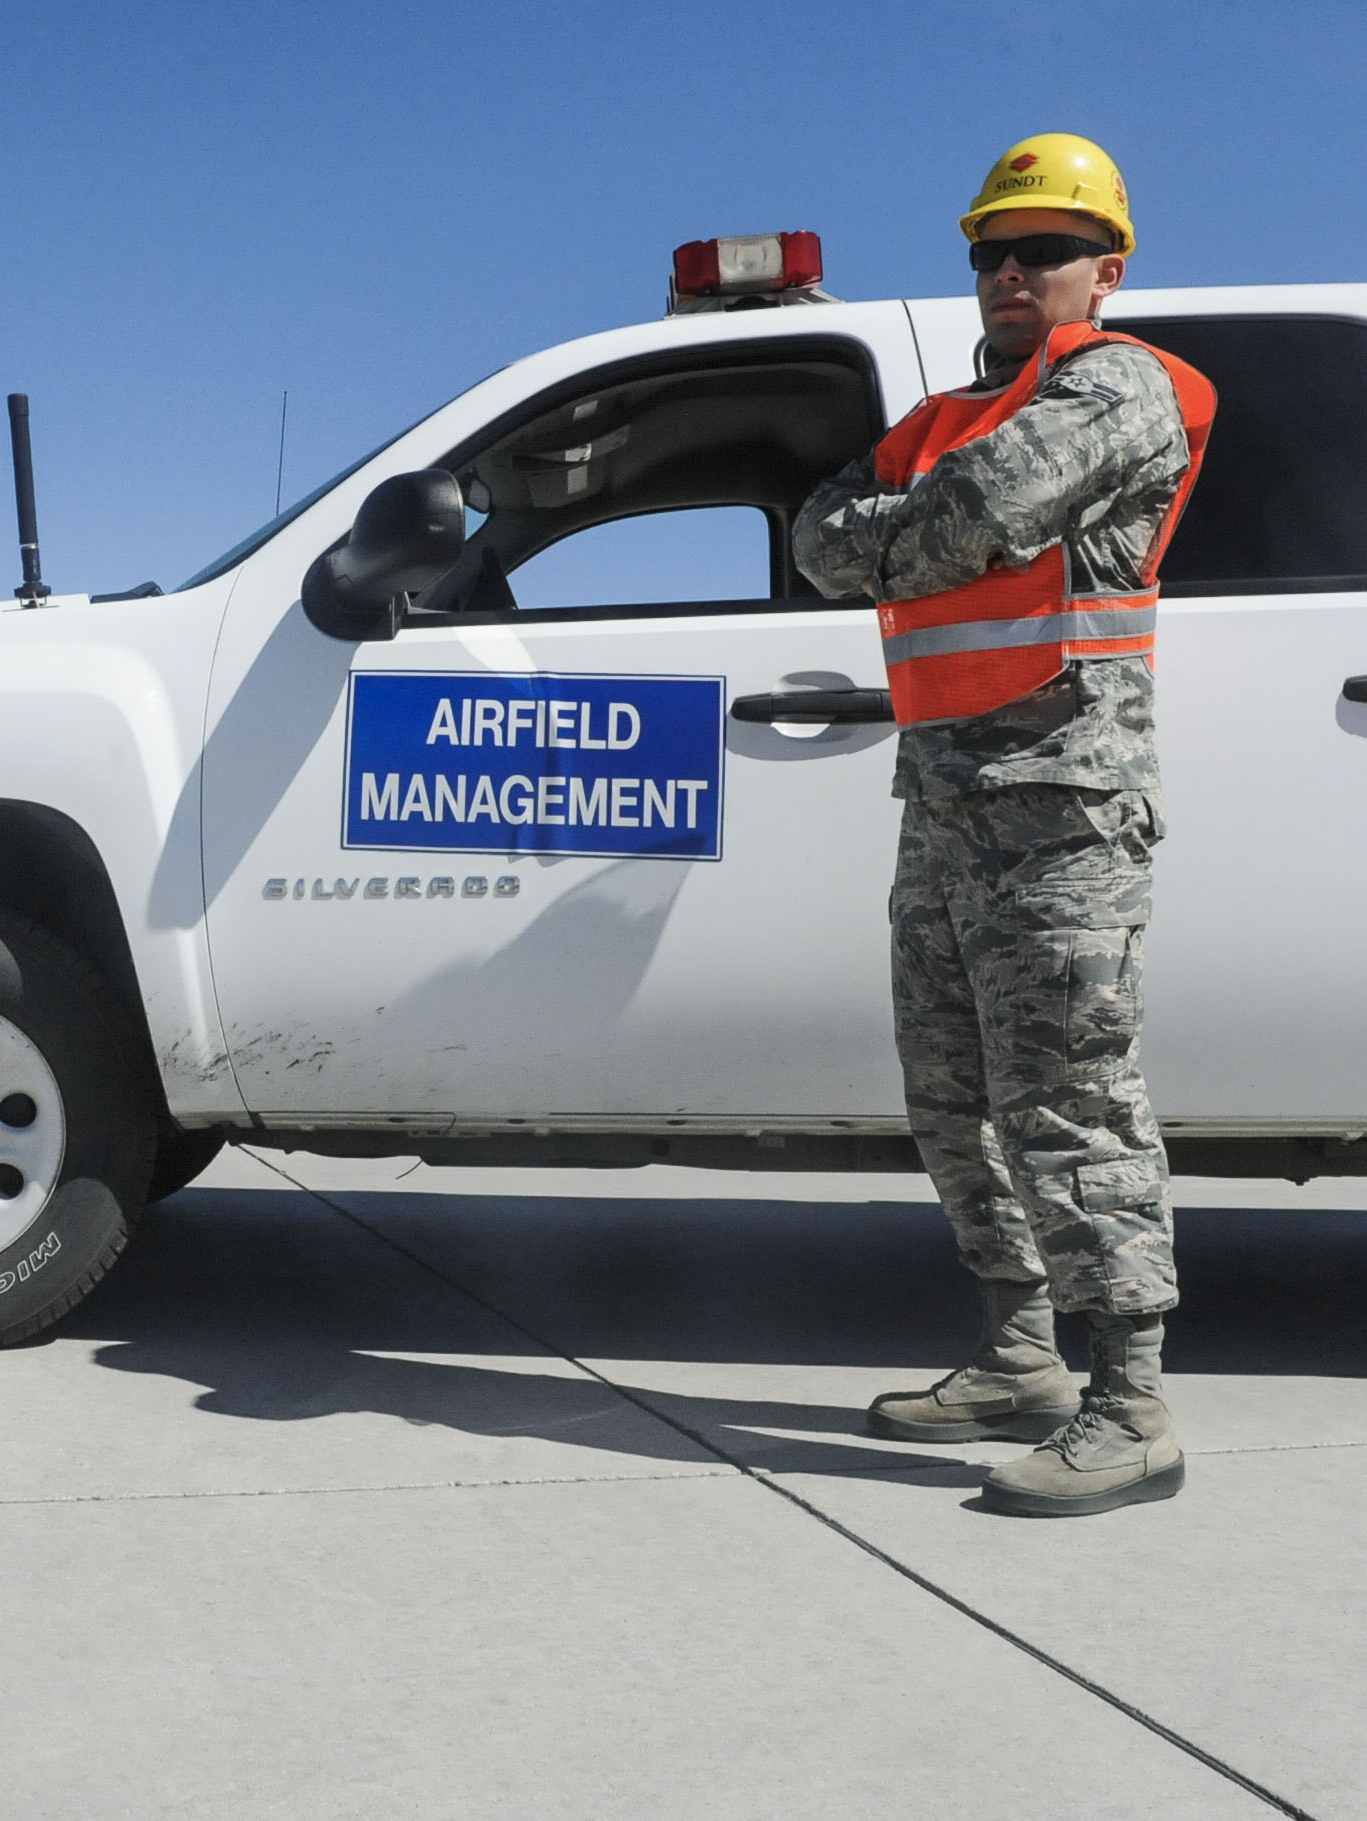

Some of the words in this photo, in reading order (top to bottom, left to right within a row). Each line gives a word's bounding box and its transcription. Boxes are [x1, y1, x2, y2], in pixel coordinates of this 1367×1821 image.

[994, 174, 1046, 193] SUNDT
[426, 698, 641, 751] AIRFIELD
[360, 772, 708, 829] MANAGEMENT
[262, 876, 520, 899] SILVERADO
